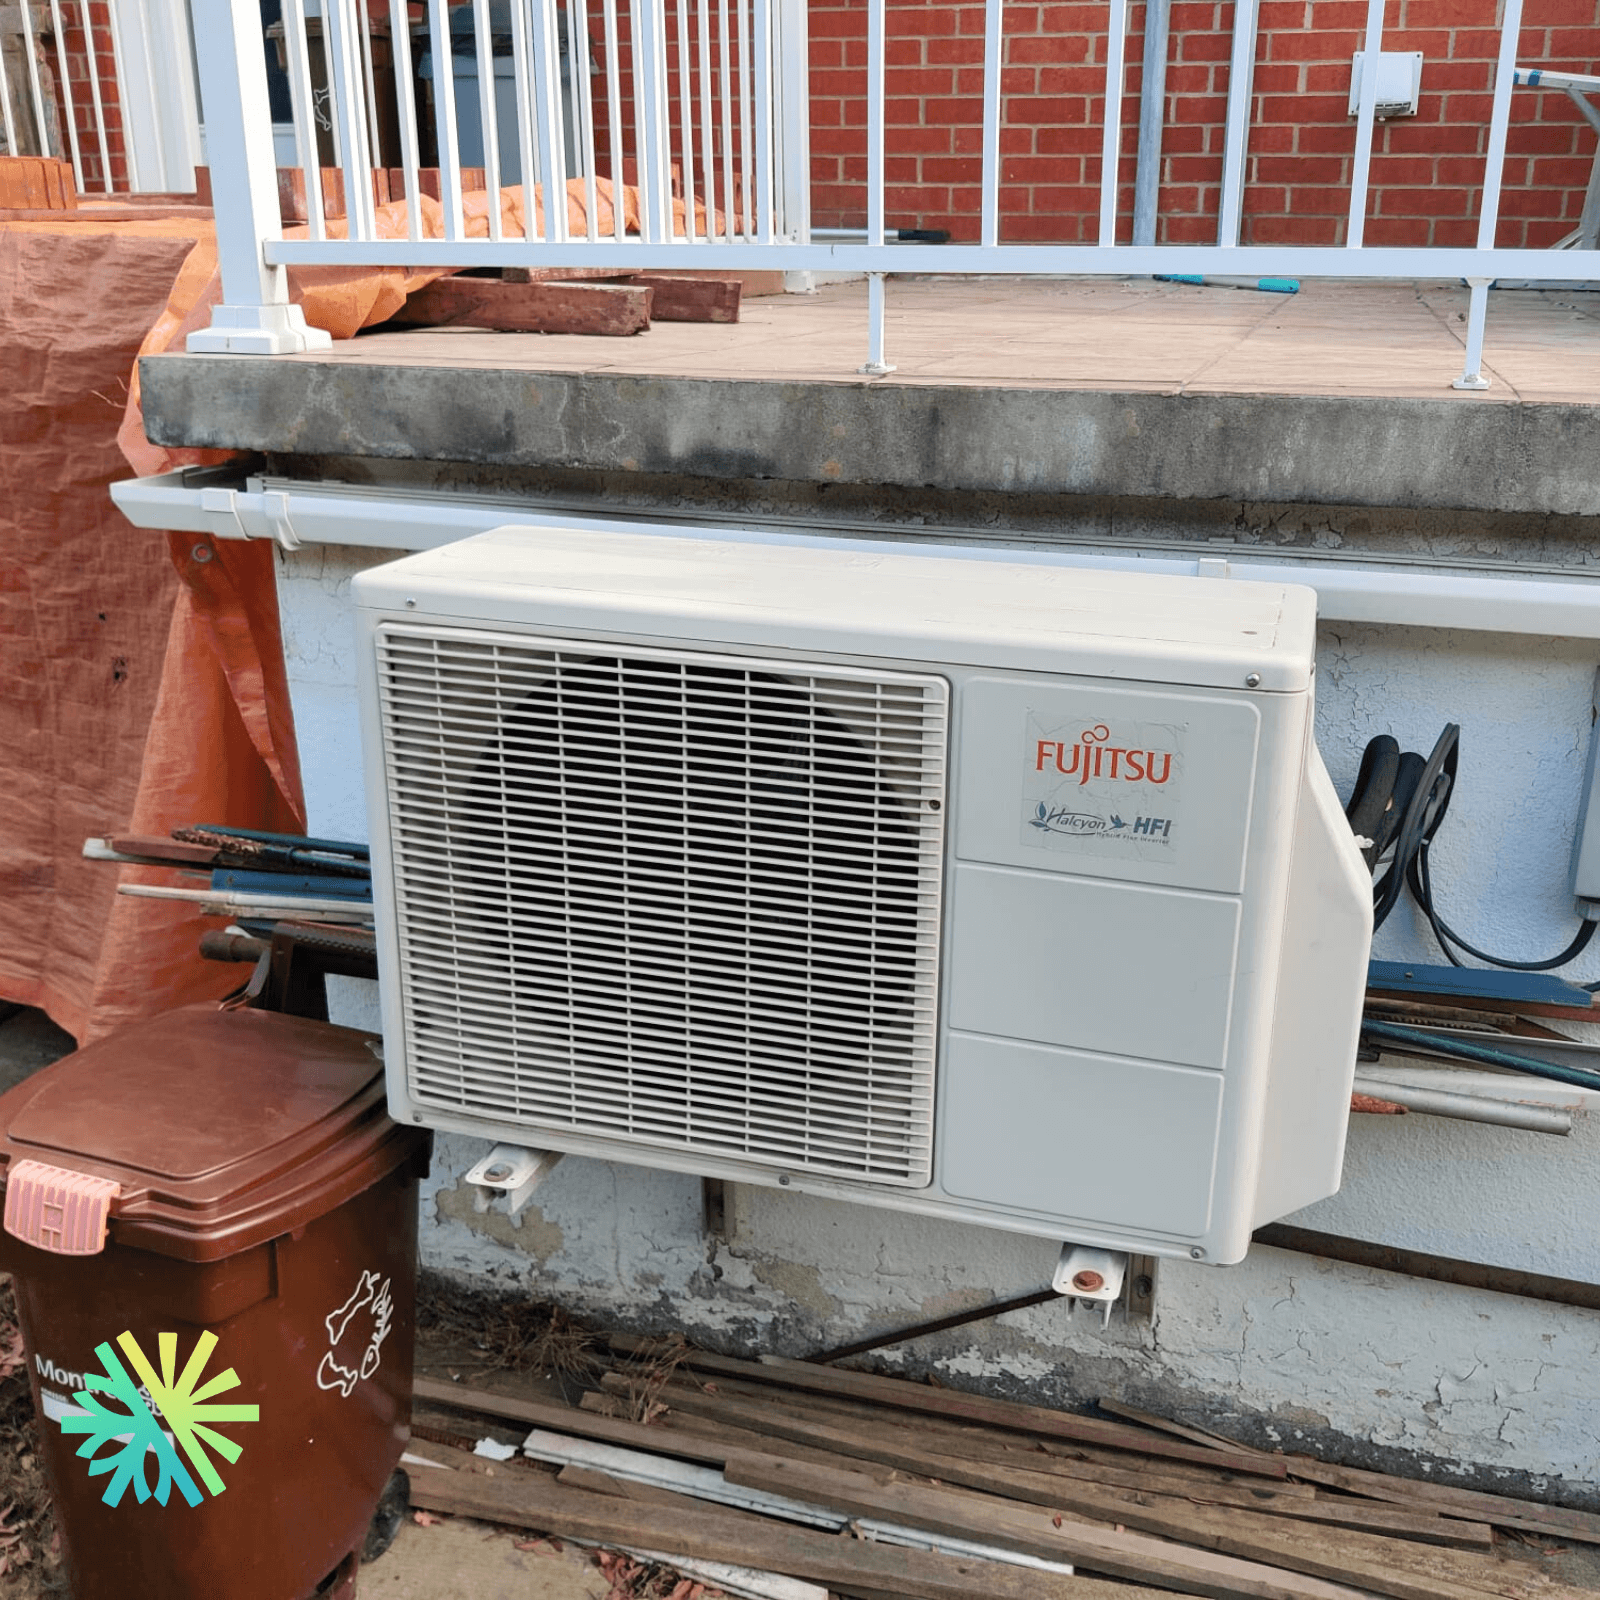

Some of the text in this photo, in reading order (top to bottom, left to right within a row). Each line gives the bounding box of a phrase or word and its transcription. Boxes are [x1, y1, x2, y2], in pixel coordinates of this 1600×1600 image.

[1036, 725, 1172, 785] FUJITSU
[1047, 807, 1172, 836] Halcyon HFI
